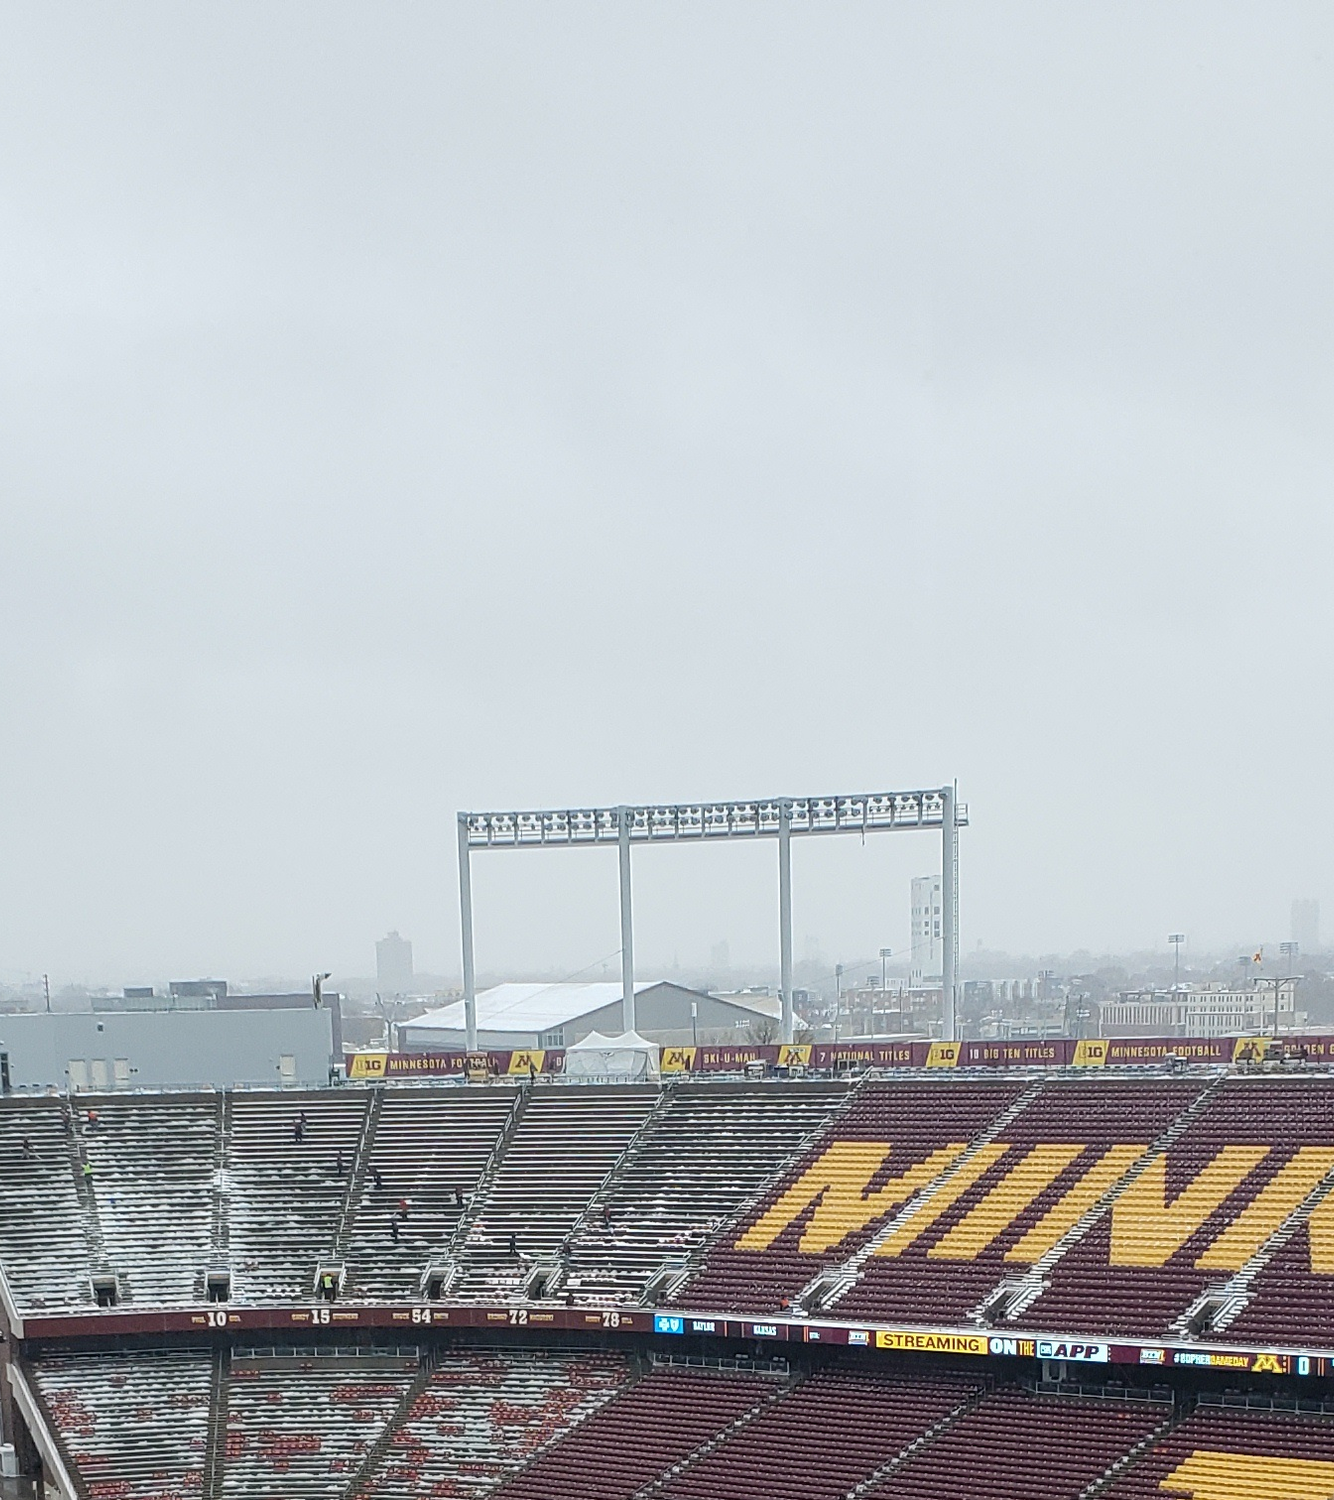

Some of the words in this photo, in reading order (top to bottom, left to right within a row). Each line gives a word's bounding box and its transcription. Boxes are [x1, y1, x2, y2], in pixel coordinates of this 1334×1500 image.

[820, 1052, 826, 1063] 7
[831, 1050, 875, 1062] NATIONAL
[879, 1050, 910, 1061] TITLES
[1004, 1047, 1020, 1059] TEN
[1025, 1047, 1055, 1058] TITLES
[1111, 1045, 1167, 1058] MINNESOTA
[390, 1058, 447, 1071] MINNESOTA
[207, 1312, 227, 1327] 10
[311, 1309, 331, 1324] 15
[411, 1308, 432, 1324] 54
[508, 1310, 528, 1325] 72
[602, 1312, 621, 1327] 78
[884, 1333, 979, 1352] STREAMING
[989, 1337, 1017, 1356] ON
[1018, 1340, 1035, 1356] THE
[1053, 1344, 1100, 1359] APP
[1298, 1356, 1310, 1375] 0
